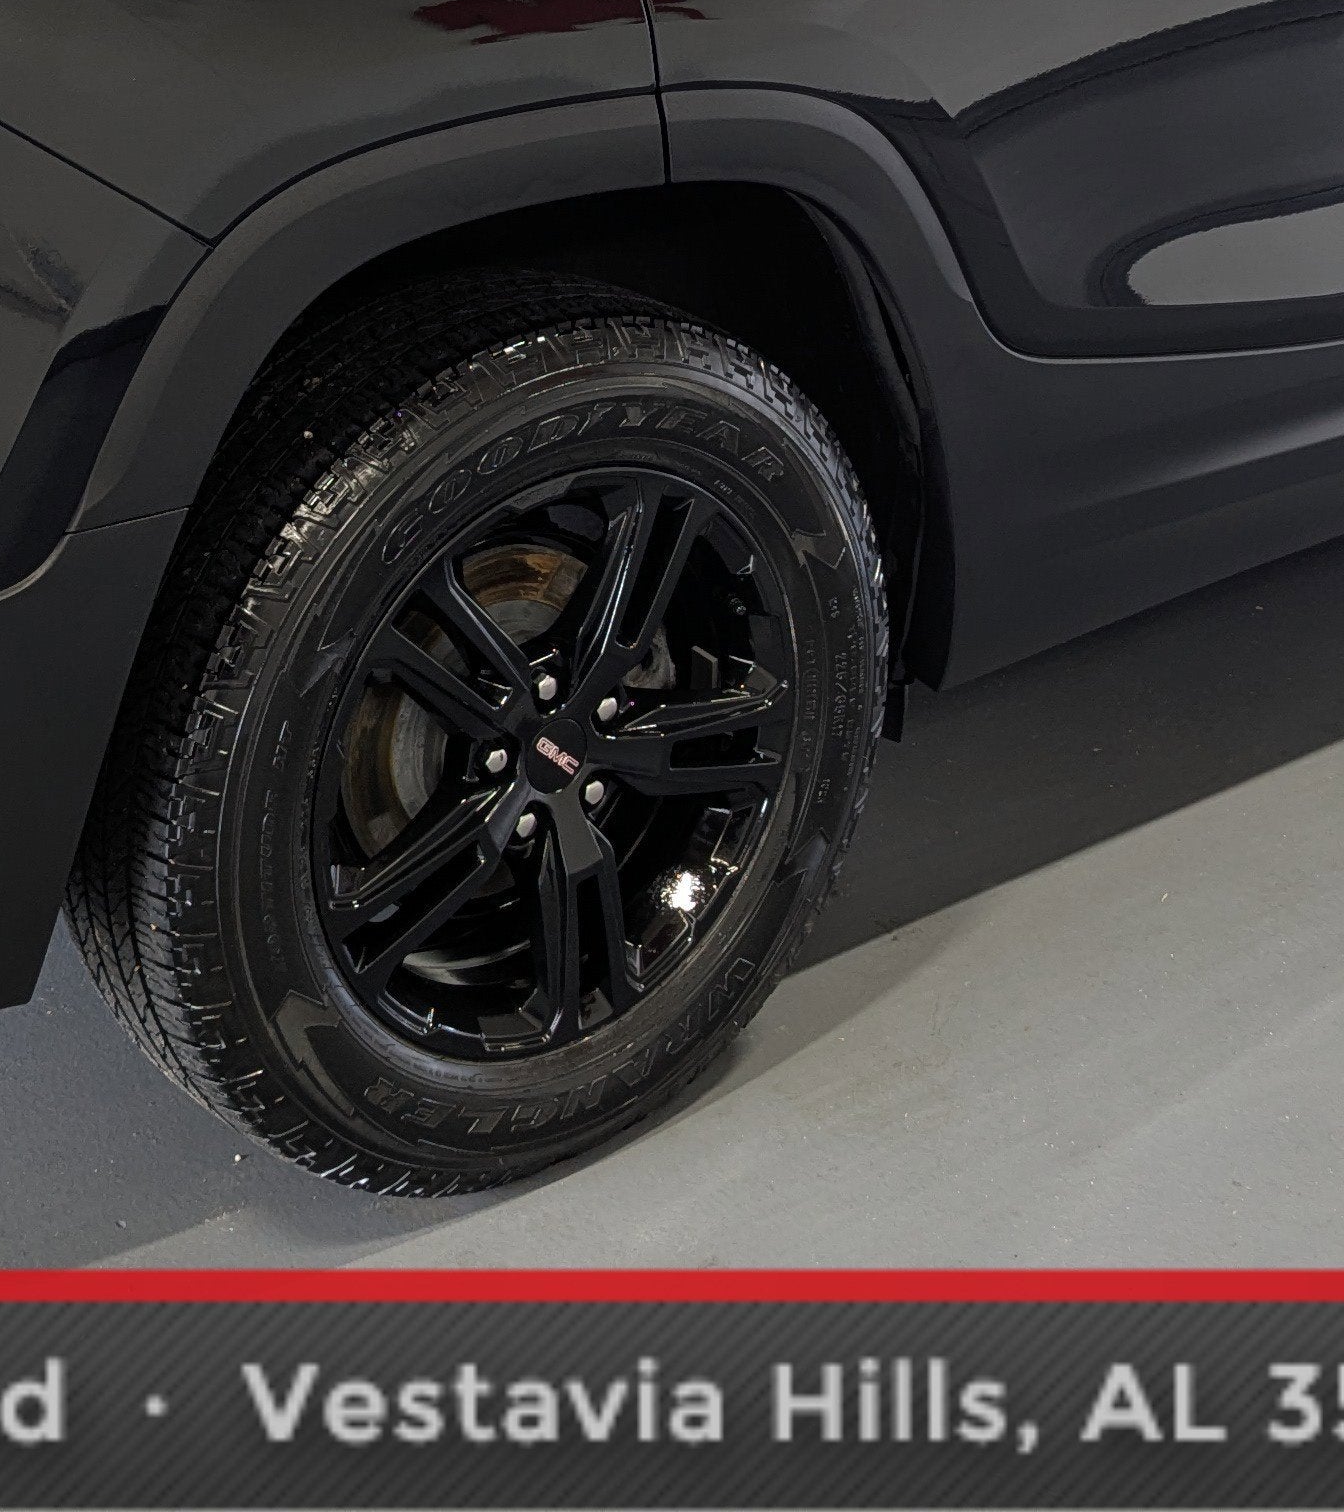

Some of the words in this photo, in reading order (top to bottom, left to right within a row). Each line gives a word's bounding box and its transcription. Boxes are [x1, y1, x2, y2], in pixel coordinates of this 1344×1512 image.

[380, 400, 787, 566] GOODYEAR
[536, 736, 580, 776] GMC
[363, 955, 758, 1136] WRANGLER
